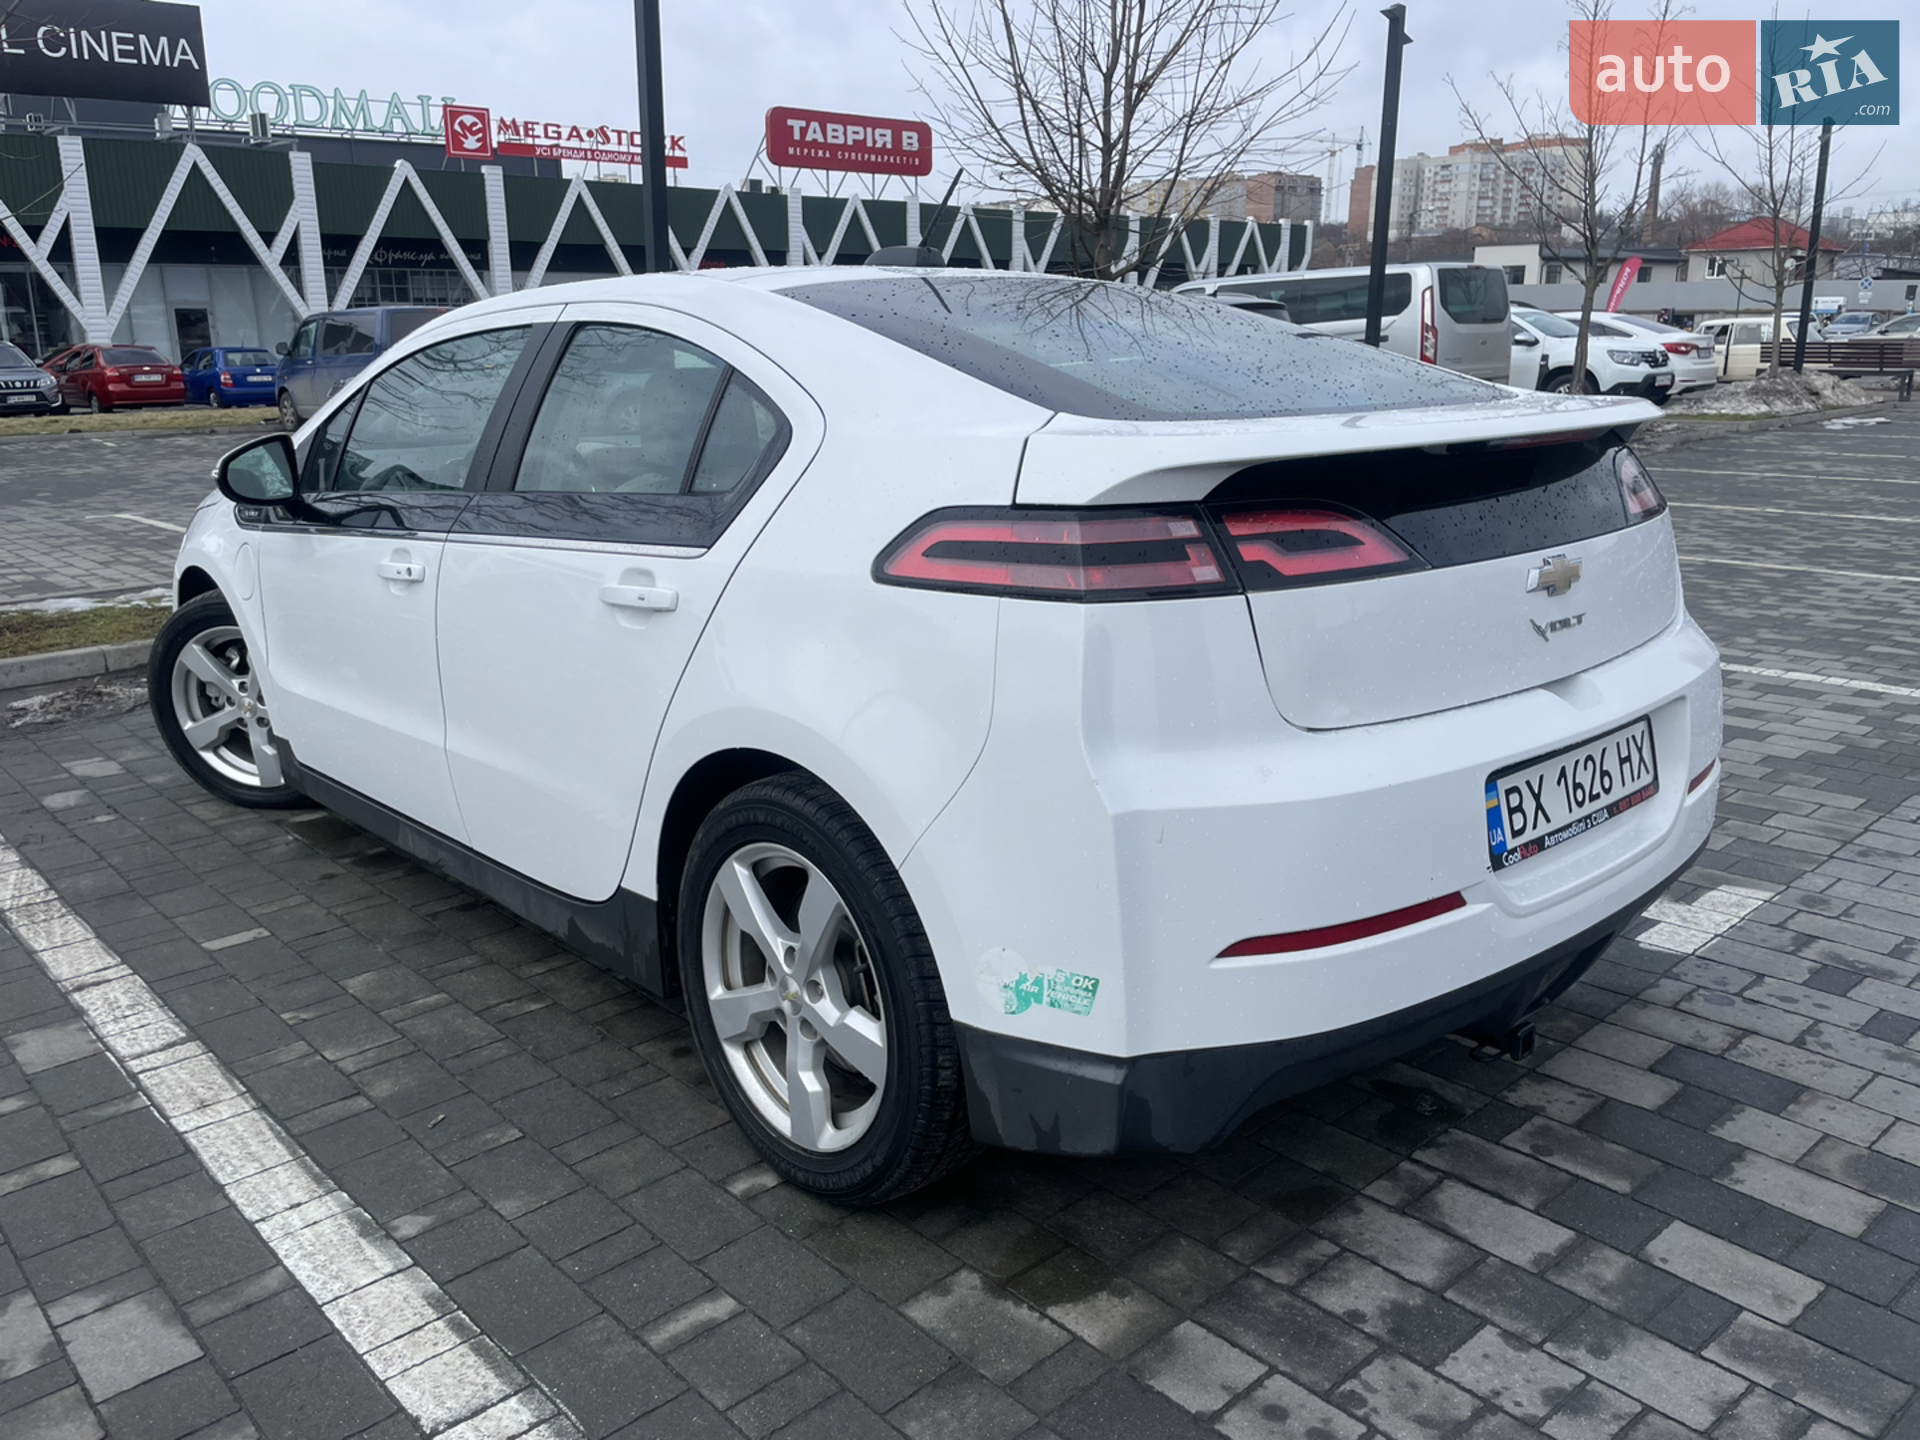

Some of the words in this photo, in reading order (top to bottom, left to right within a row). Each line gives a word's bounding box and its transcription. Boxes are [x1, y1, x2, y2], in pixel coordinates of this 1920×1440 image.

[37, 24, 200, 70] CINEMA
[787, 118, 892, 149] ТАВРІЯ
[902, 130, 920, 151] В
[535, 145, 551, 158] УСІ
[553, 147, 585, 161] БРЕНДИ
[587, 150, 593, 160] В
[594, 151, 632, 164] ОДНОМУ
[788, 147, 831, 158] МЕРЕЖА
[837, 151, 920, 165] СУПЕРМАРКЕТІВ
[1529, 612, 1587, 642] VOLT
[1489, 828, 1504, 846] UA
[1504, 774, 1551, 839] BX
[1557, 746, 1613, 814] 1626
[1616, 730, 1650, 788] HX
[1544, 822, 1586, 848] Автомобілі
[1591, 809, 1609, 826] США
[1071, 975, 1096, 990] OK
